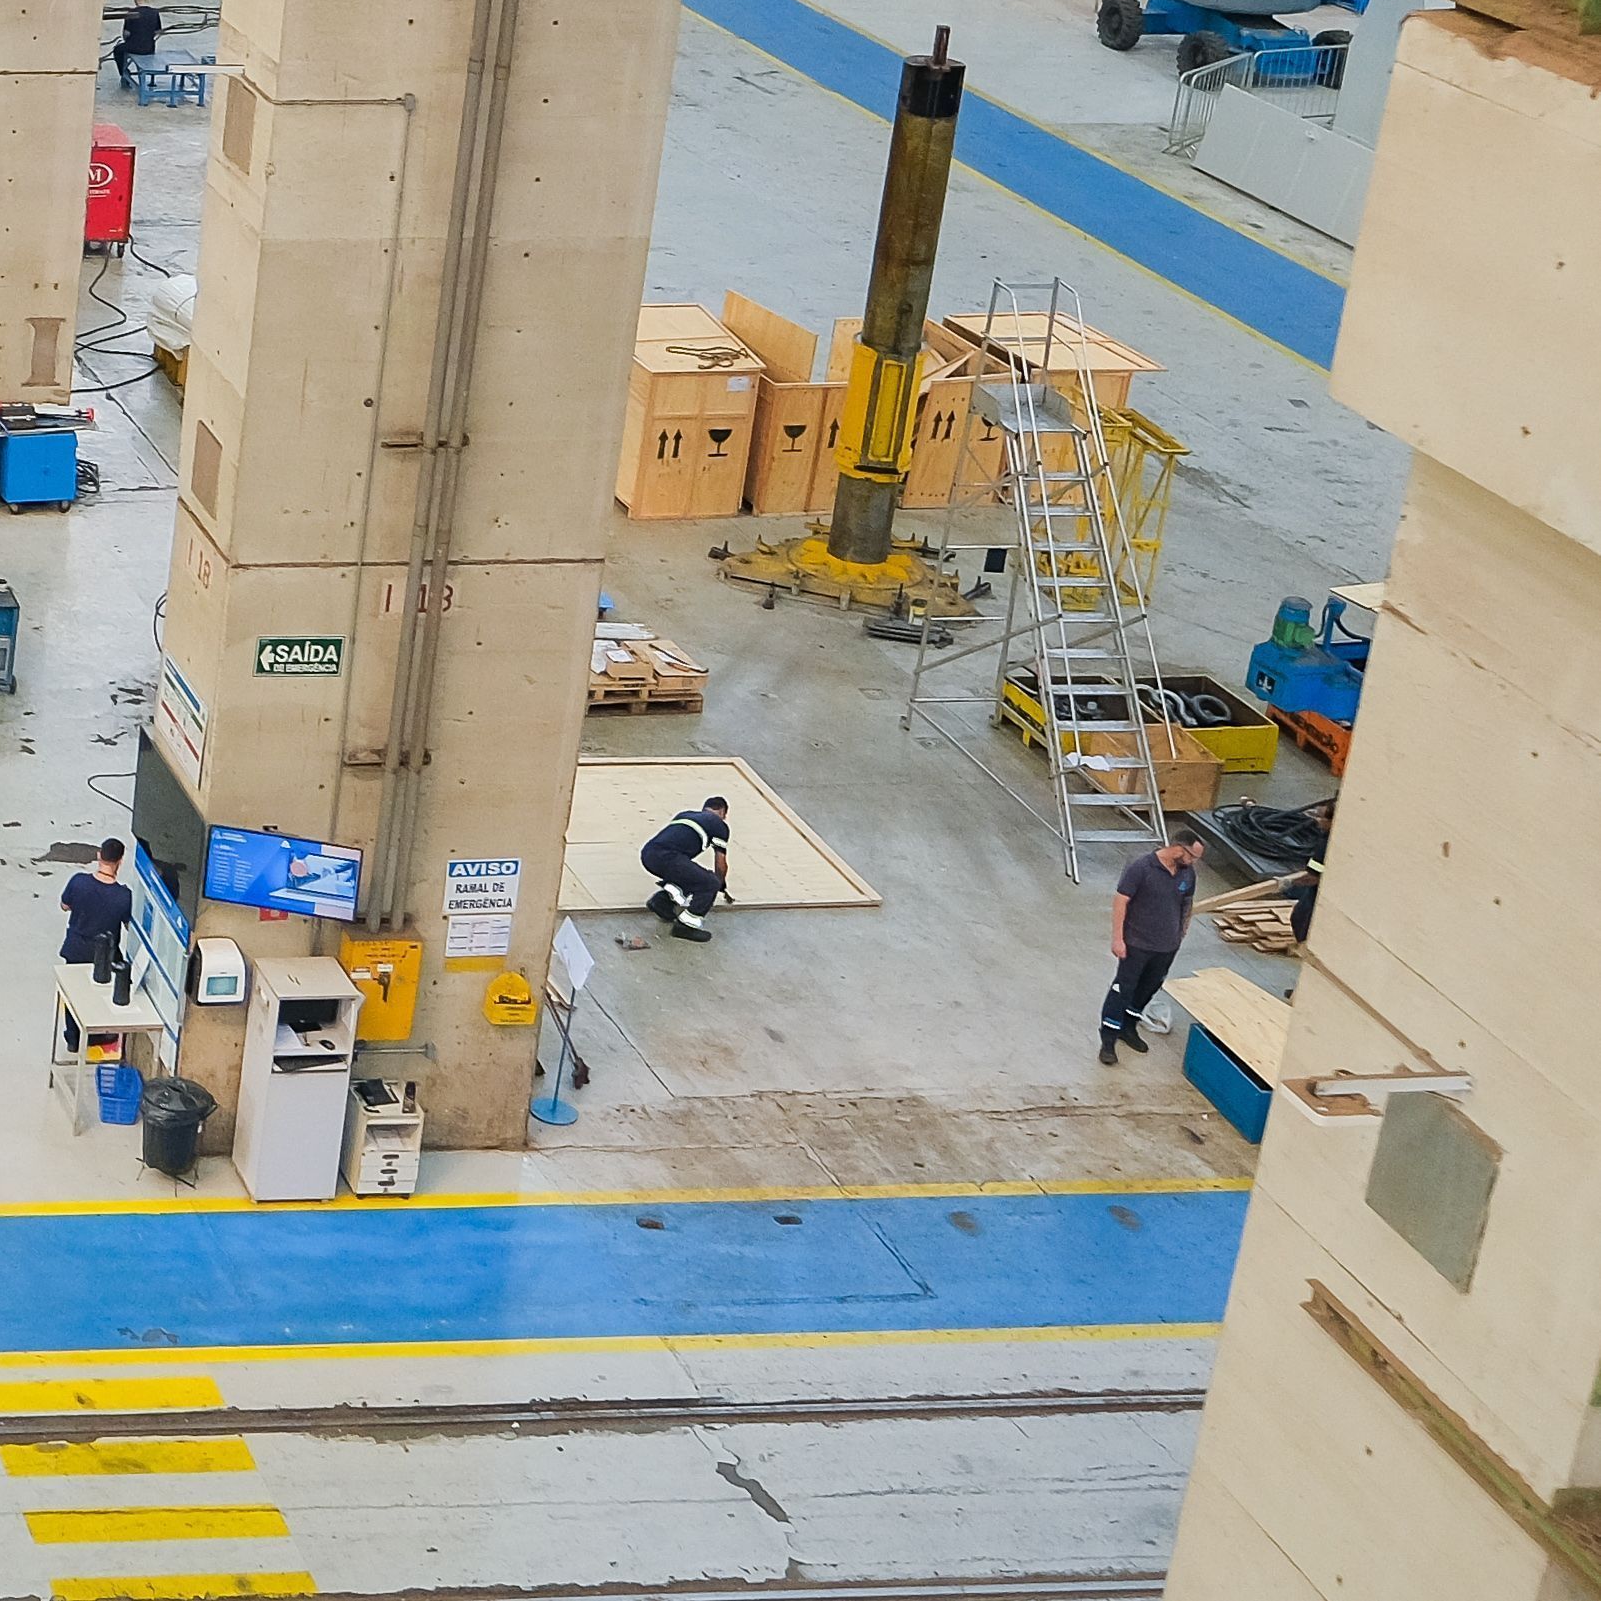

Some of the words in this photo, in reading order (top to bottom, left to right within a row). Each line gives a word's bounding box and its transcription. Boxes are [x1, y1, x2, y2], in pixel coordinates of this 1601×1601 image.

[275, 640, 339, 663] SAÍDA
[451, 861, 517, 876] AVISO
[455, 883, 490, 894] RAMAL
[492, 882, 505, 893] DE
[448, 897, 513, 910] EMERGÊNCIA
